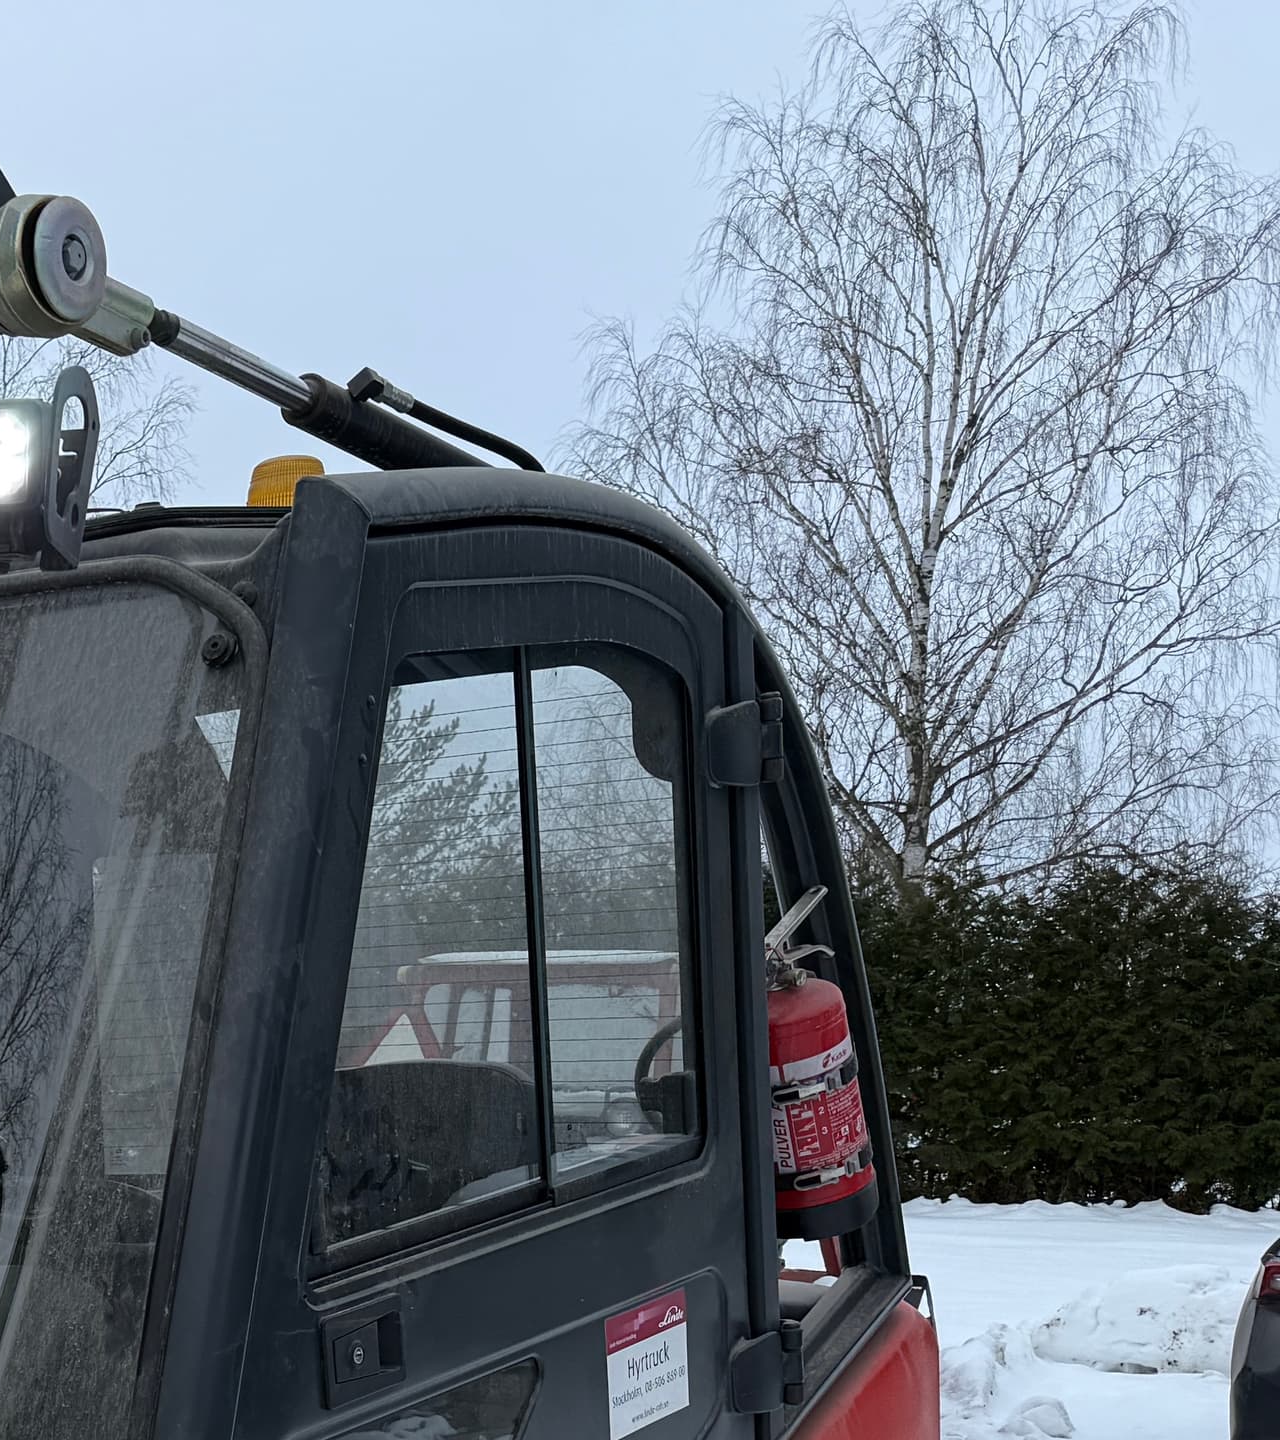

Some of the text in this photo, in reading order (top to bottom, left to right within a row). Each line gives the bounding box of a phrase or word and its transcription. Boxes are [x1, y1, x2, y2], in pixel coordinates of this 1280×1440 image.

[818, 1106, 825, 1115] 2
[821, 1126, 828, 1135] 3
[774, 1119, 792, 1168] PULVER
[658, 1305, 684, 1328] Linde
[627, 1341, 671, 1382] Hyrtruck
